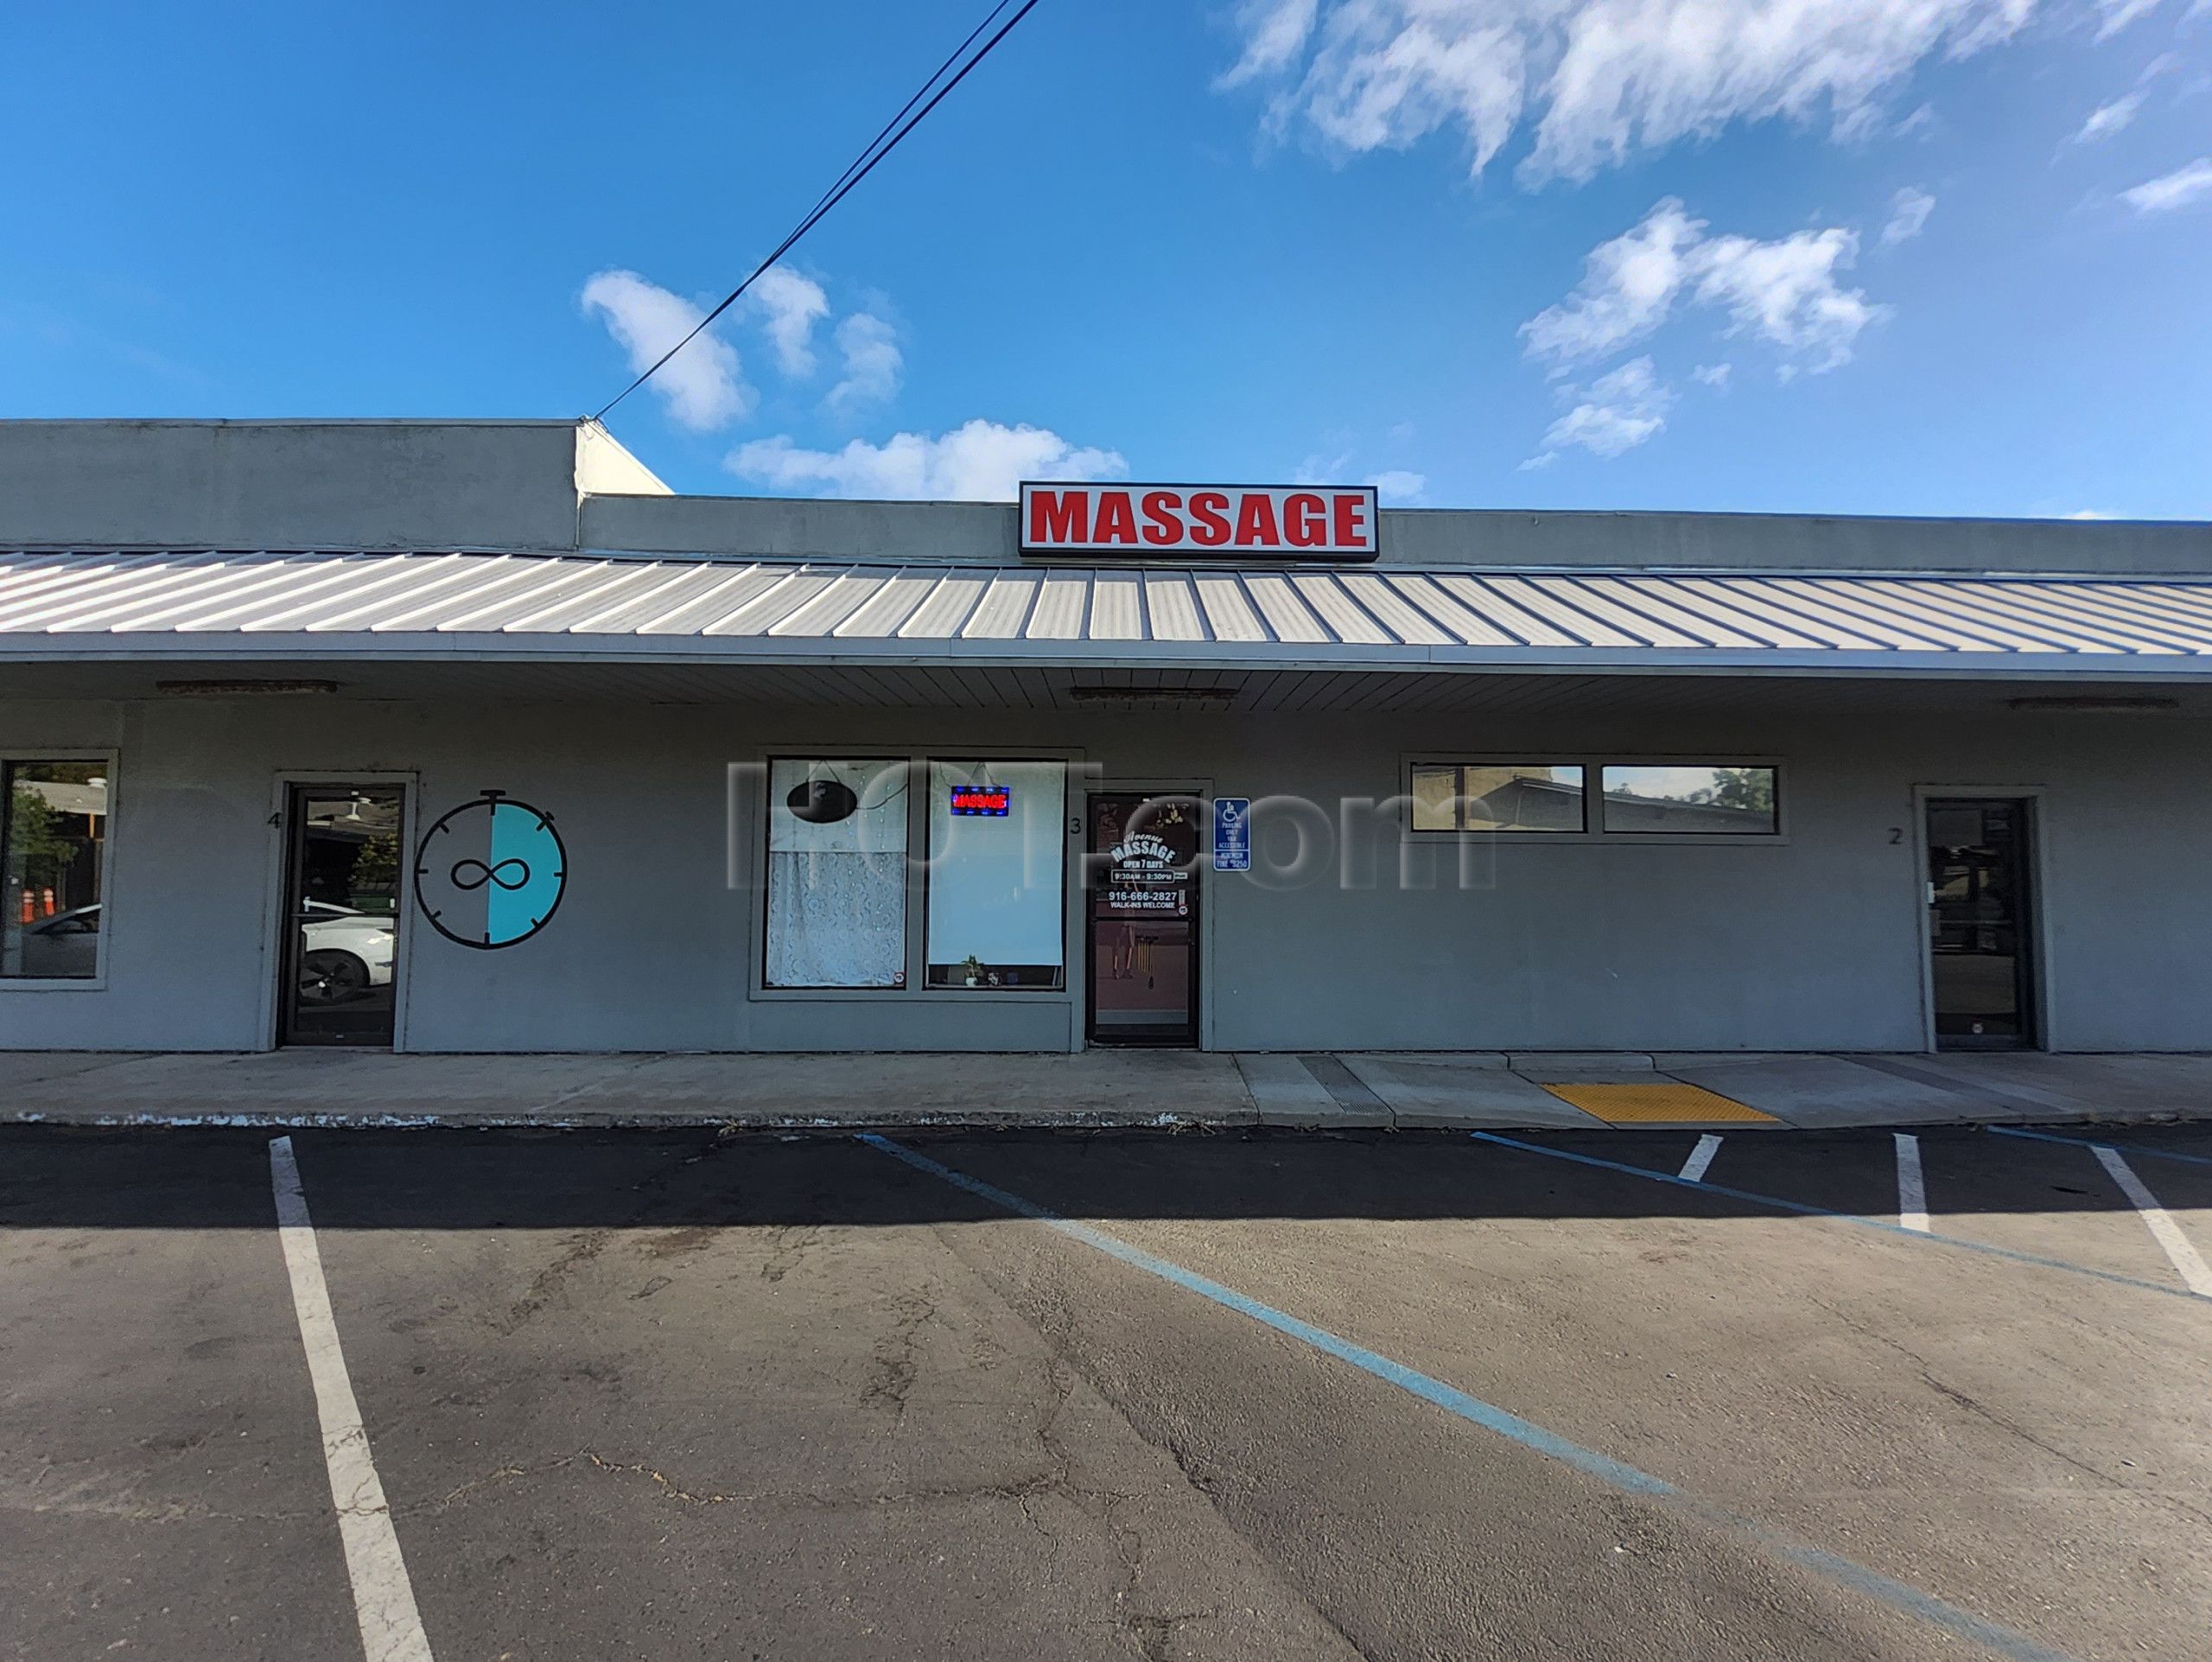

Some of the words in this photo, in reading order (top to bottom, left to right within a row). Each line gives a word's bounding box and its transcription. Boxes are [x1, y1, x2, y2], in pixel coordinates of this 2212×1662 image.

[1030, 490, 1367, 547] MASSAGE
[953, 794, 1007, 809] MASSAGE
[267, 812, 281, 829] 4
[1071, 818, 1081, 834] 3
[1123, 831, 1163, 844] Avenue
[1888, 827, 1904, 845] 2
[1110, 840, 1176, 863] MASSAGE
[1123, 860, 1141, 869] OPEN
[1141, 859, 1147, 869] 7
[1147, 860, 1164, 869] DAYS
[1109, 891, 1177, 901] 916-666-2827
